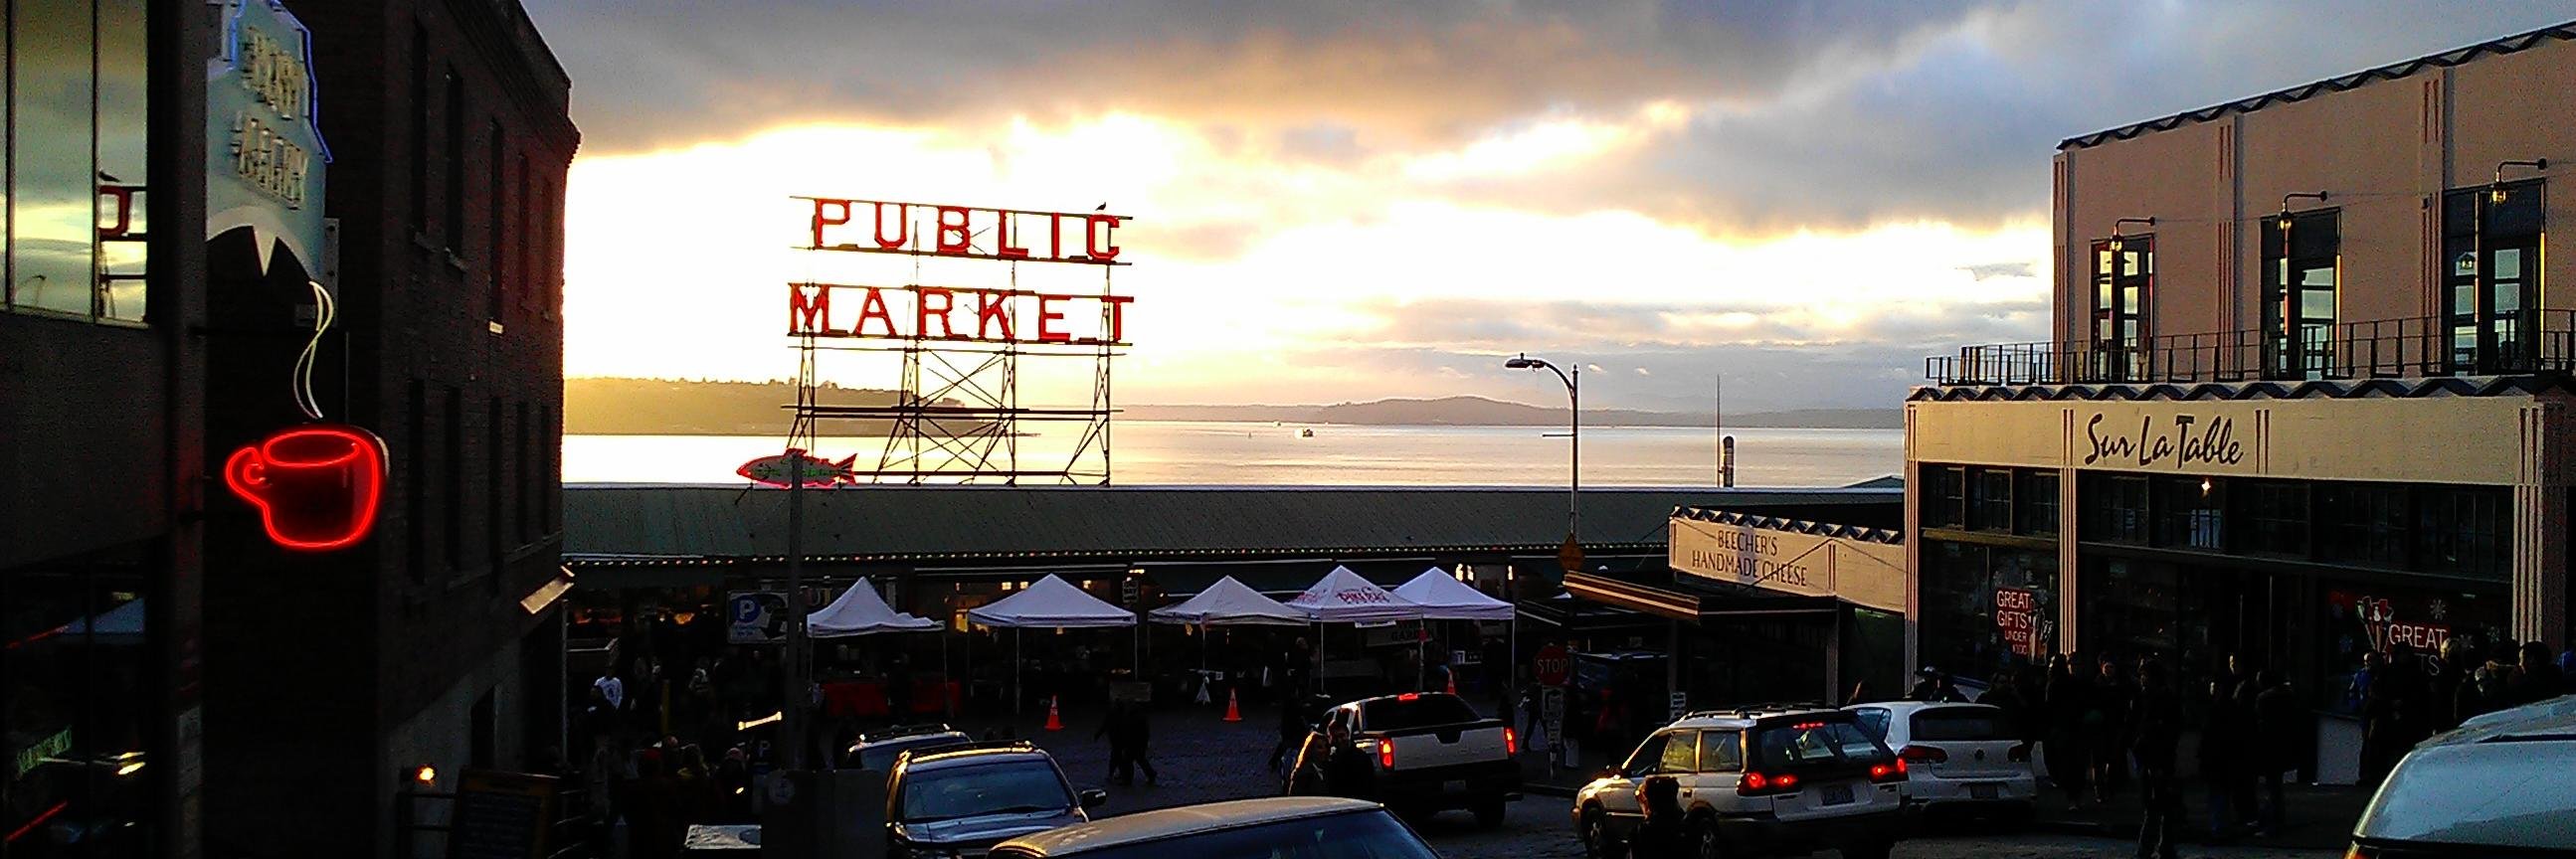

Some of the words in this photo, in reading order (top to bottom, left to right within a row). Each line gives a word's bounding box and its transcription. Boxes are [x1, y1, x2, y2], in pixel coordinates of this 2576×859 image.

[814, 199, 1120, 260] PUBLIC
[789, 282, 1134, 343] MARKET
[2085, 414, 2136, 465] Sur
[2139, 416, 2175, 466] La
[2175, 415, 2244, 469] Table
[1718, 530, 1778, 557] BEECHER'S
[1693, 550, 1758, 579] HANDMADE
[1761, 560, 1807, 587] CHEESE
[739, 599, 756, 619] P
[1996, 590, 2032, 609] GREAT
[1996, 609, 2028, 629] GIFTS
[2388, 623, 2449, 649] GREAT
[1537, 658, 1568, 674] STOP
